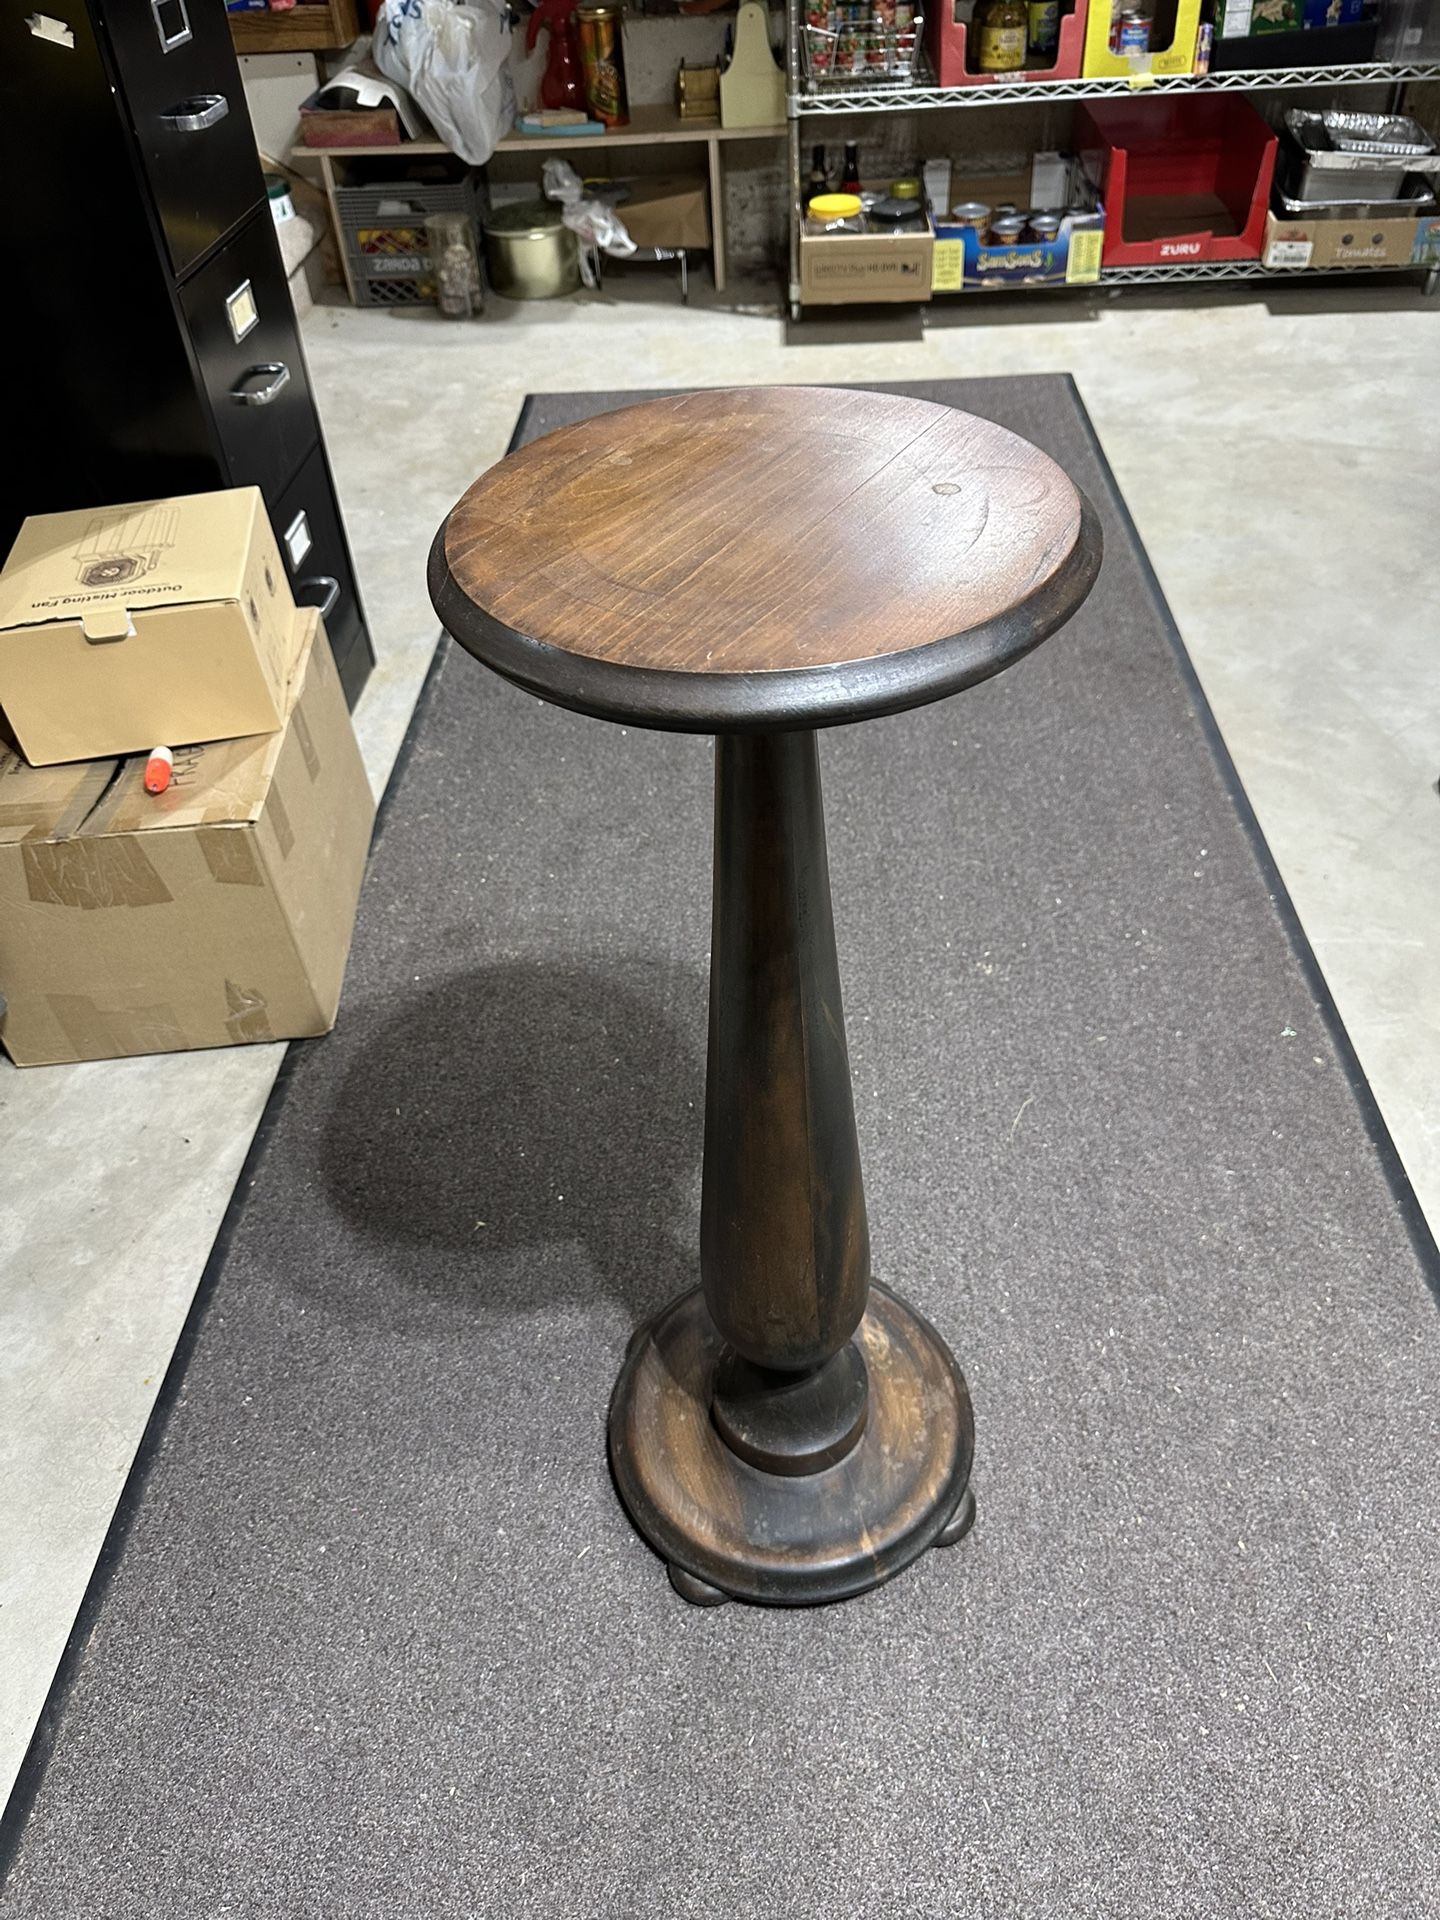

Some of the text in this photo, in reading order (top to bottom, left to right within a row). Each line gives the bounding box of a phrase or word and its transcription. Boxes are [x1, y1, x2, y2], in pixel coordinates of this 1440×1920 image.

[1160, 242, 1201, 256] ZURU
[31, 584, 183, 609] Outdoor Misting Fan
